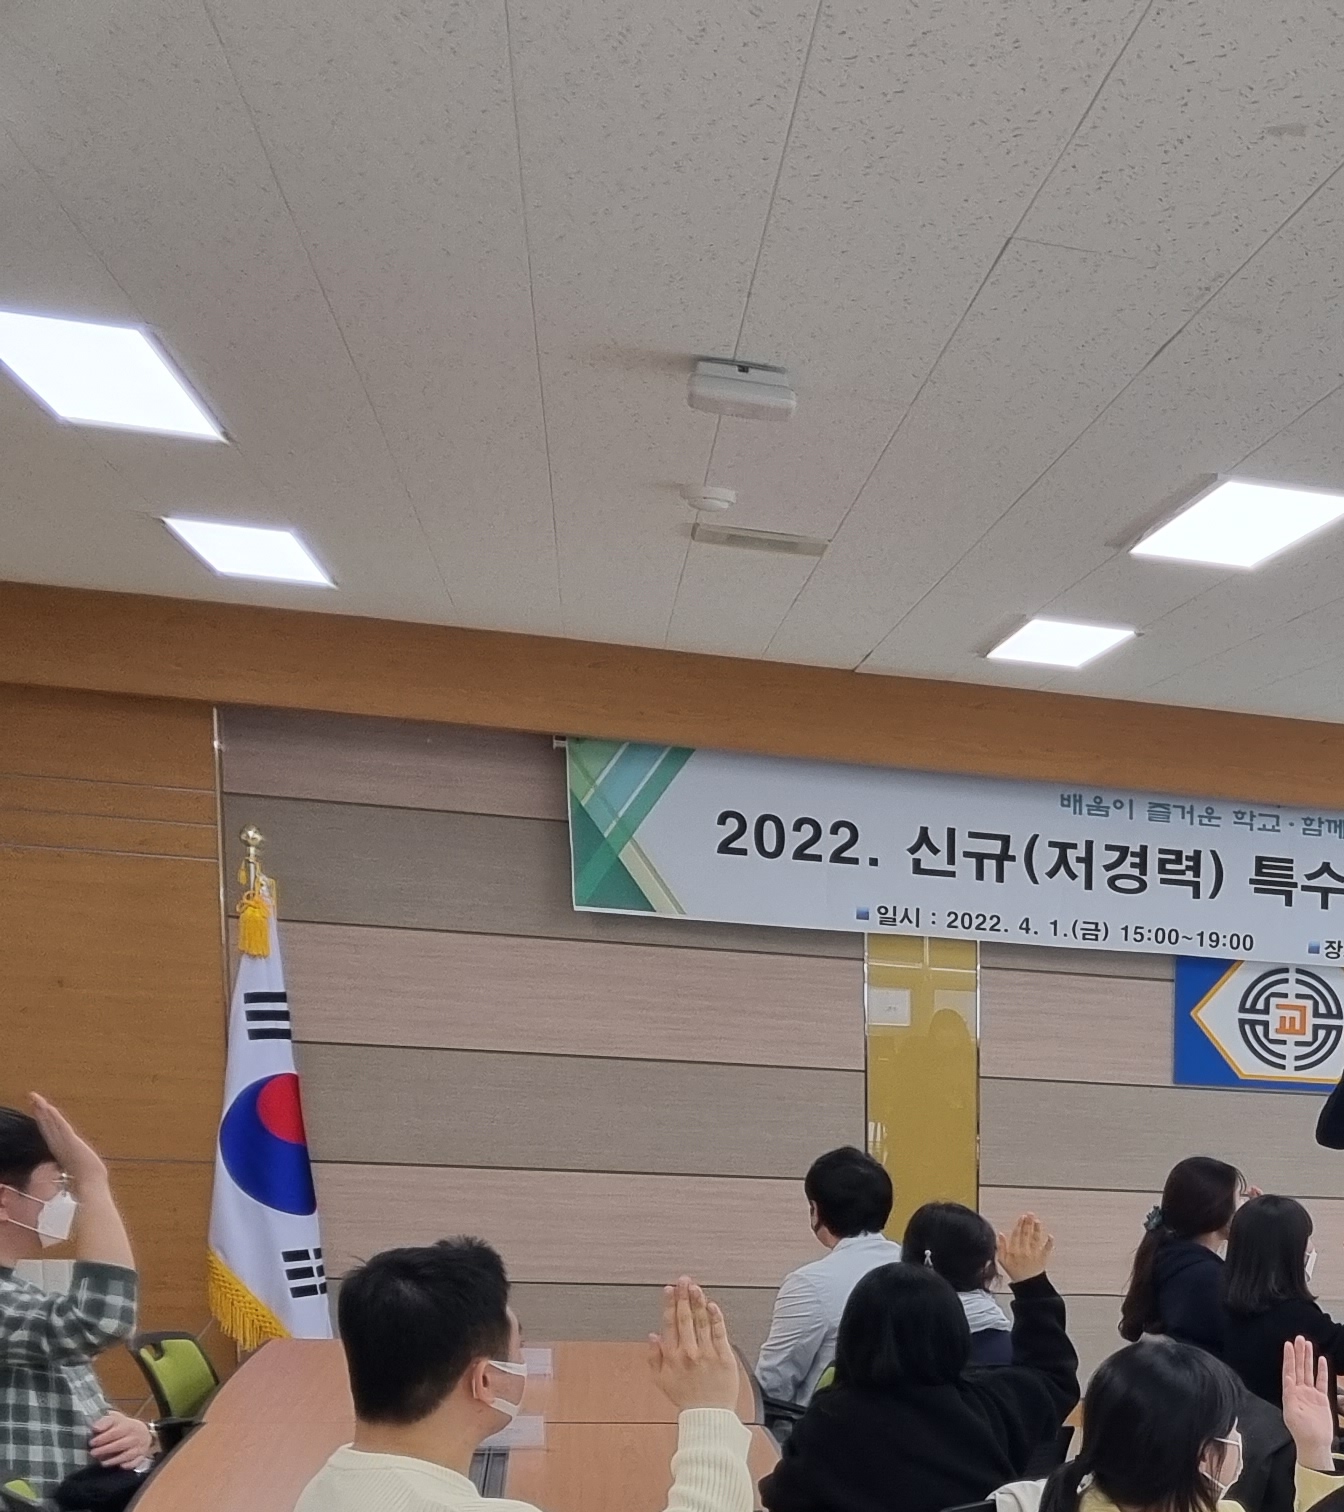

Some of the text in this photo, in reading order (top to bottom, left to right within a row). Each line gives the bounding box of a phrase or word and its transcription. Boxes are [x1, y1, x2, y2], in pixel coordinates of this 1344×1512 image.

[1059, 793, 1134, 821] 배움이
[1146, 801, 1223, 828] 즐거운
[716, 809, 879, 868] 2022.
[905, 825, 1225, 901] 신규(저경력)
[876, 905, 921, 929] 일시
[946, 910, 1009, 933] 2022.
[1118, 924, 1254, 954] 15:00~19:00
[1275, 1003, 1307, 1036] 교
